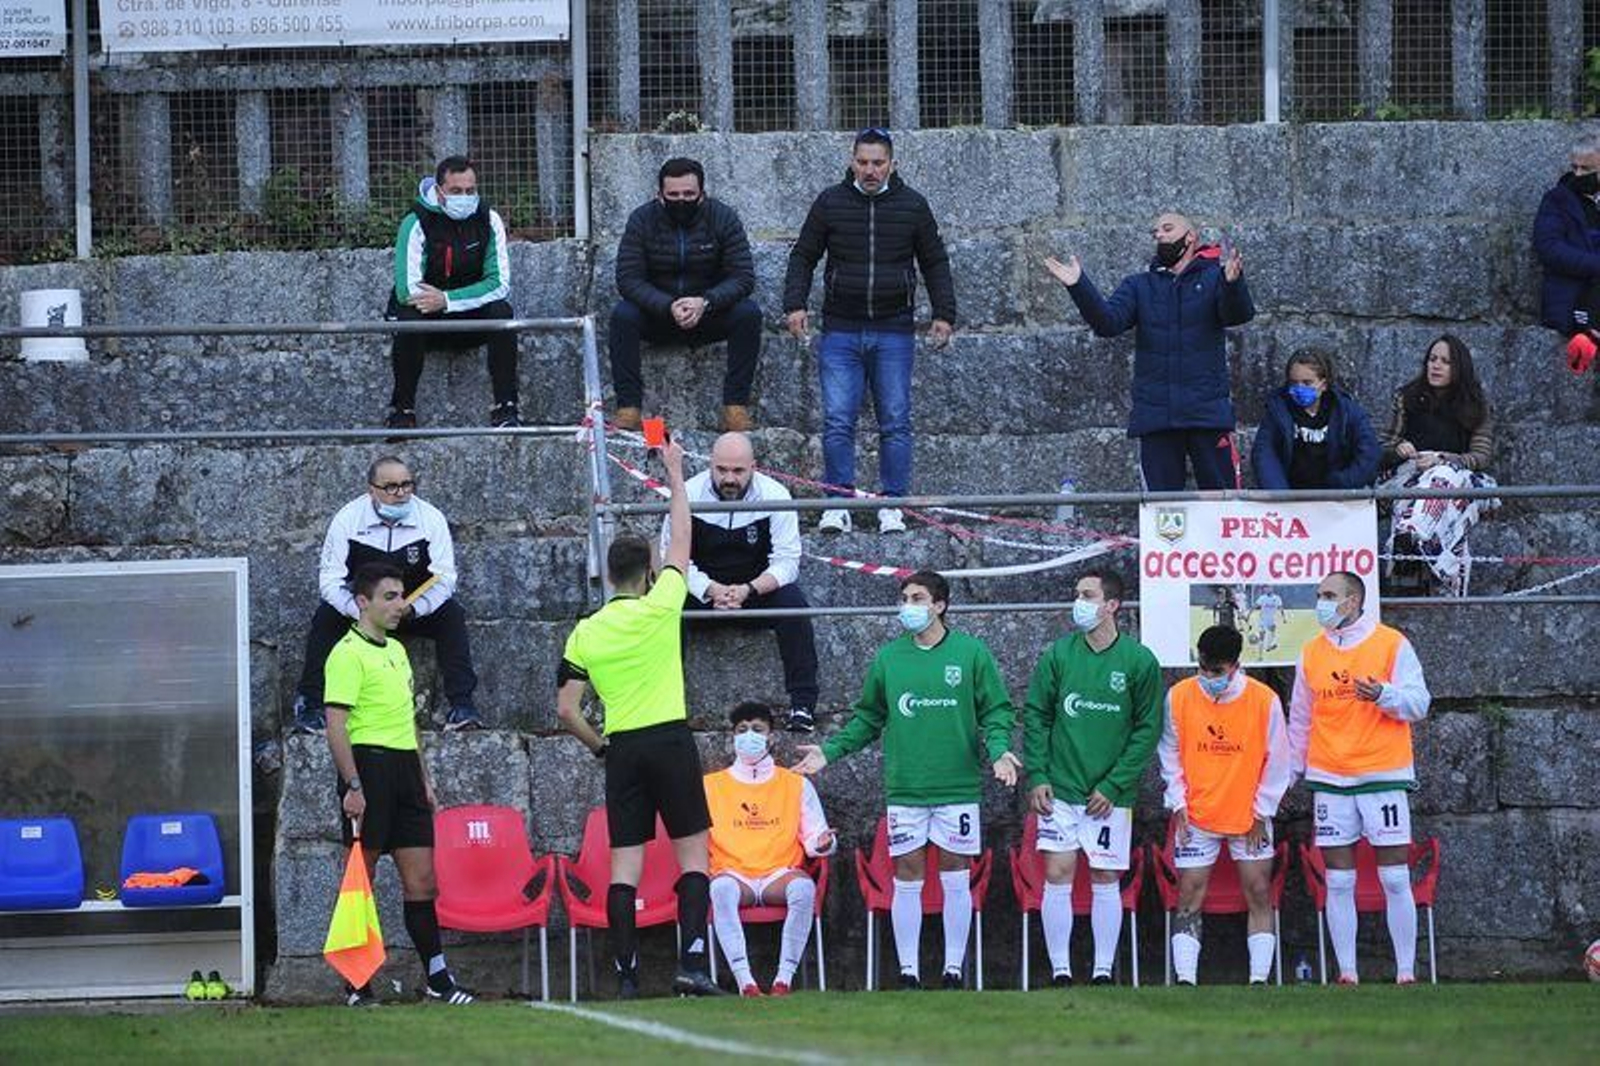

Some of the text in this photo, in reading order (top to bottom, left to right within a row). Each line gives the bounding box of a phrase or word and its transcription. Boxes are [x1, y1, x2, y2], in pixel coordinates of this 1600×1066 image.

[141, 19, 169, 37] 988
[174, 18, 202, 35] 210
[208, 17, 234, 35] 103
[250, 17, 278, 34] 696
[283, 15, 310, 33] 500
[315, 14, 343, 32] 455
[386, 14, 544, 32] www.friborpa.com
[1220, 512, 1309, 538] PEÑA
[1144, 543, 1375, 579] acceso centro
[959, 813, 971, 837] 6
[1381, 804, 1399, 828] 11
[1097, 825, 1111, 850] 4
